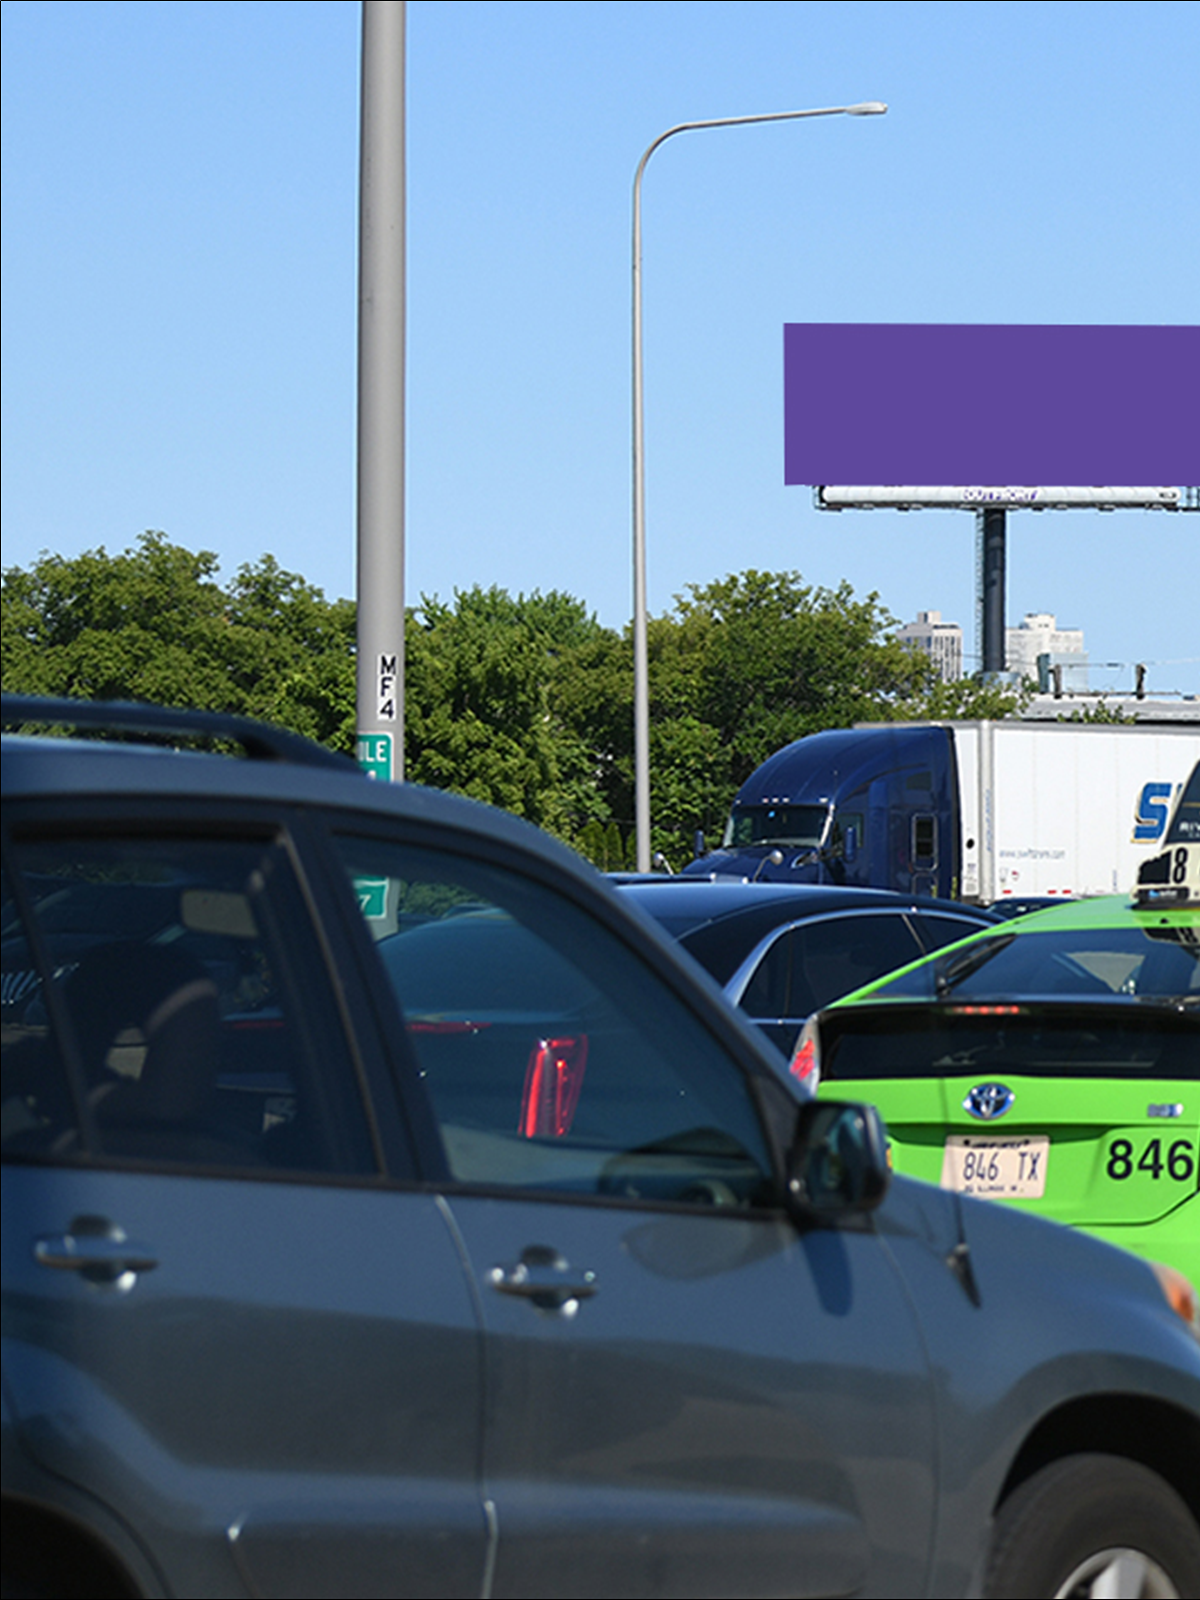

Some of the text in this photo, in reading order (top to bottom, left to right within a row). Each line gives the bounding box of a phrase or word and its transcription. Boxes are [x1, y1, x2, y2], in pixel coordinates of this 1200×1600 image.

[1132, 782, 1183, 843] S
[963, 1151, 1042, 1181] 846 TX
[1107, 1139, 1194, 1181] 846
